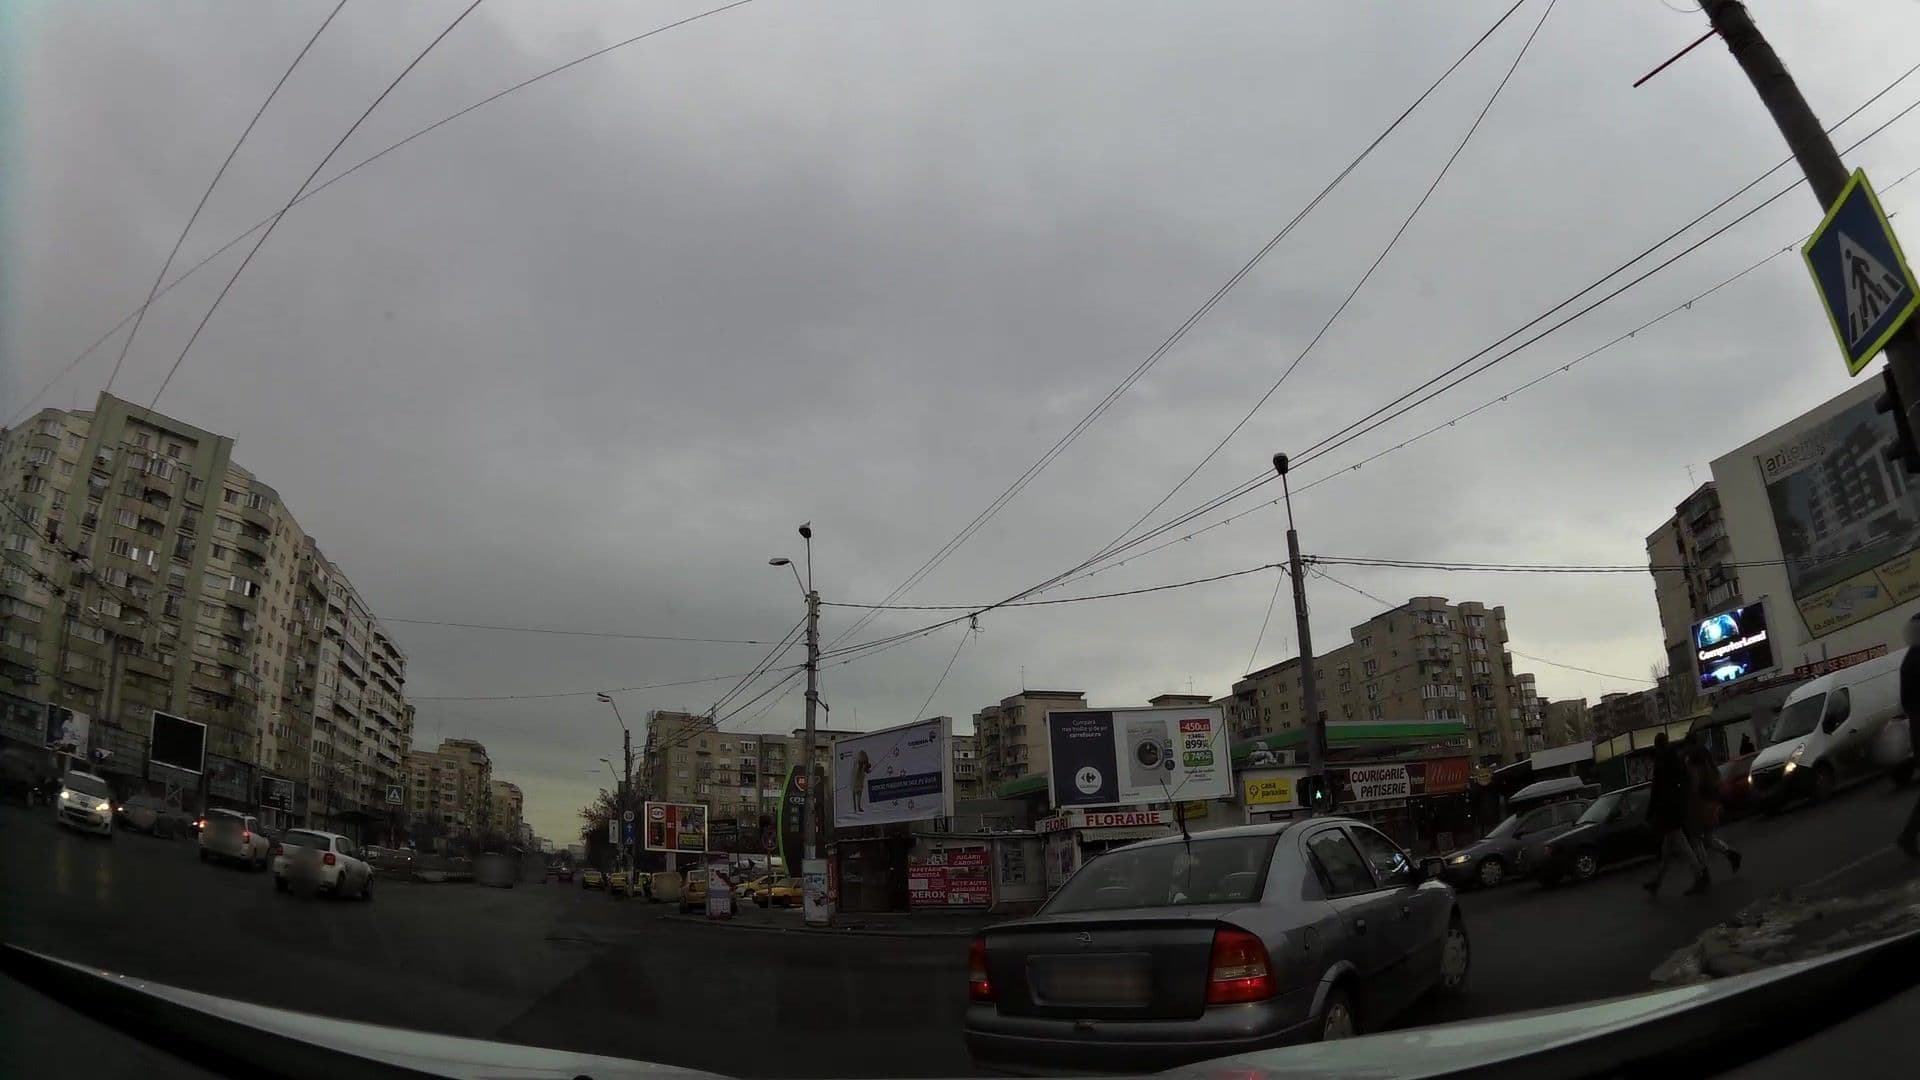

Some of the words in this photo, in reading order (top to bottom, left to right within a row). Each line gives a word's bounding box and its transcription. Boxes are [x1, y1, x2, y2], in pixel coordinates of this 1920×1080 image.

[1360, 783, 1406, 797] PATISERIE
[1085, 812, 1160, 826] FLORARIE
[912, 890, 946, 899] XEROX
